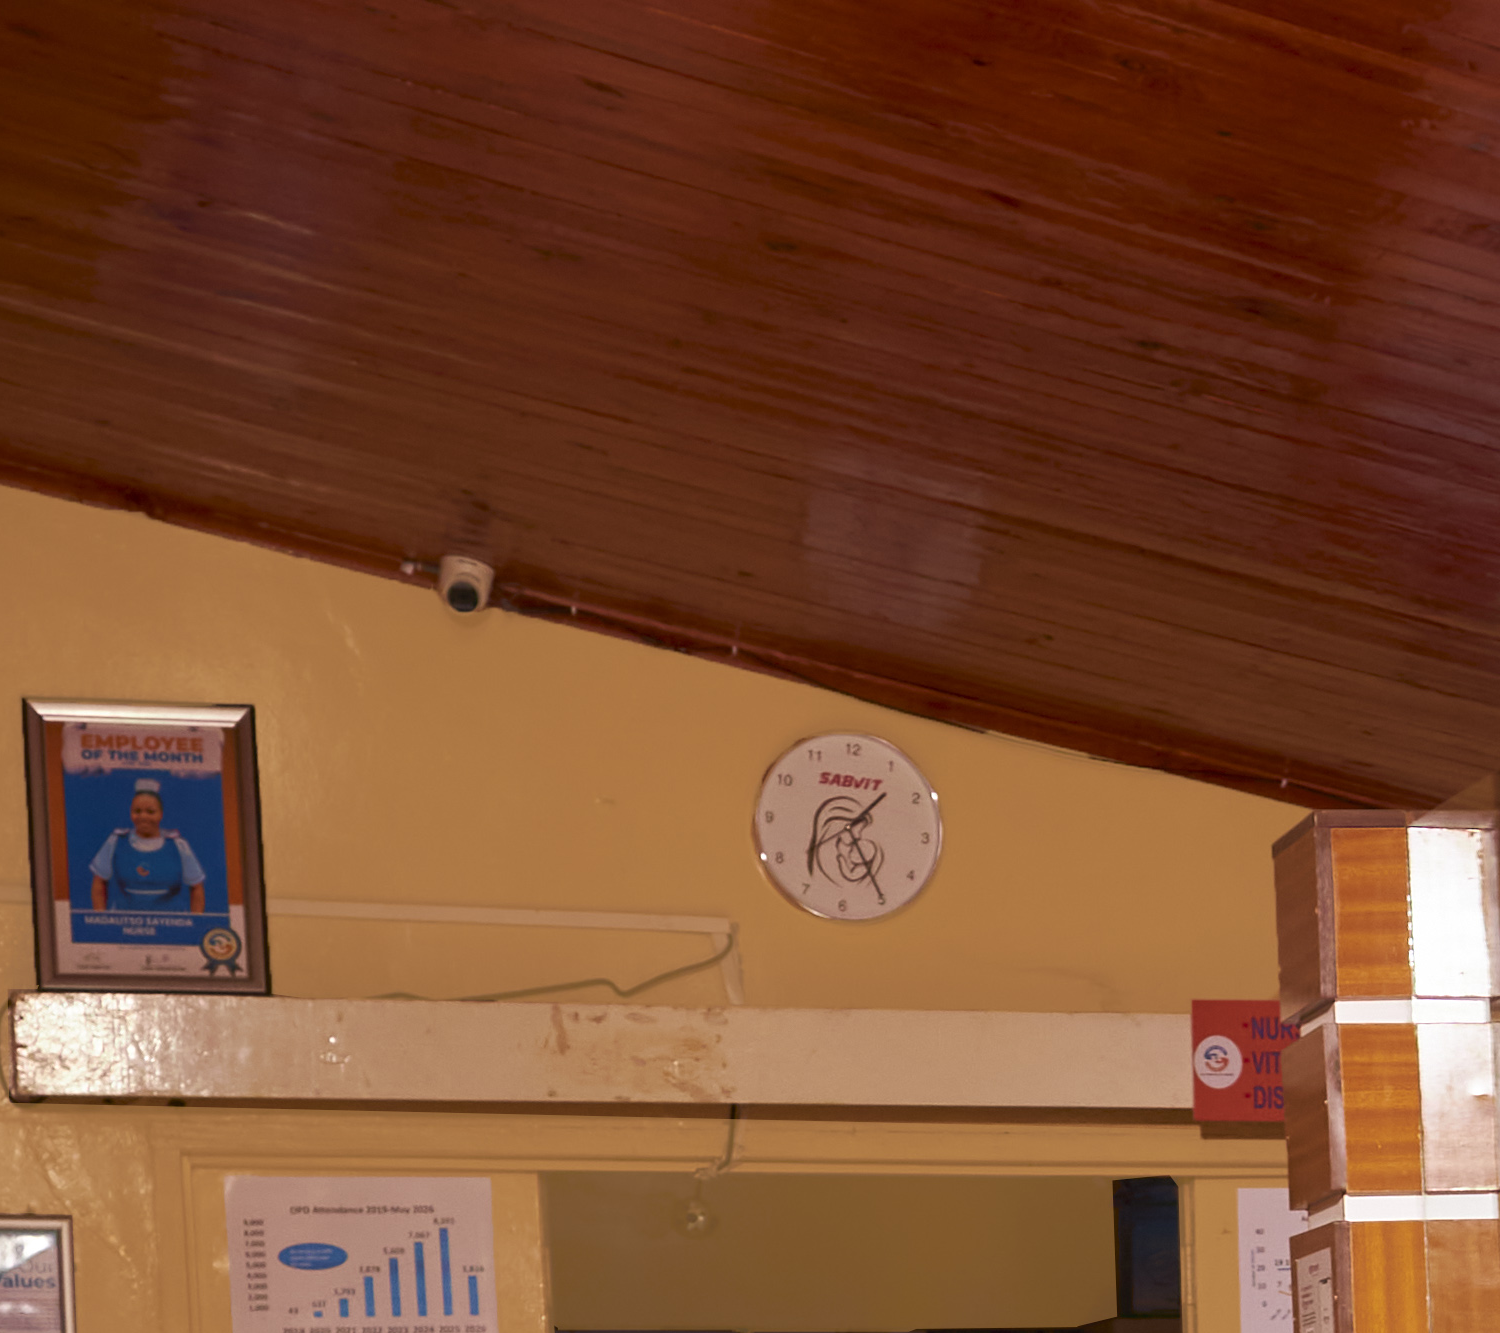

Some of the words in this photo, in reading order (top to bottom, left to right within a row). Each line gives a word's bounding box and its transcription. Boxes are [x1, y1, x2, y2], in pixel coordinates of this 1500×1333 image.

[81, 734, 203, 752] EMPLOYEE
[81, 750, 102, 760] OF
[108, 750, 138, 761] THE
[144, 751, 203, 763] MONTH
[808, 749, 822, 762] 11
[846, 743, 861, 757] 12
[888, 760, 894, 772] 1
[777, 773, 793, 787] 10
[912, 792, 921, 804] 2
[765, 811, 774, 823] 9
[921, 832, 930, 844] 3
[906, 869, 915, 881] 4
[802, 883, 810, 894] 7
[838, 901, 846, 912] 6
[1252, 1051, 1281, 1074] VIT
[1253, 1086, 1284, 1109] DIS
